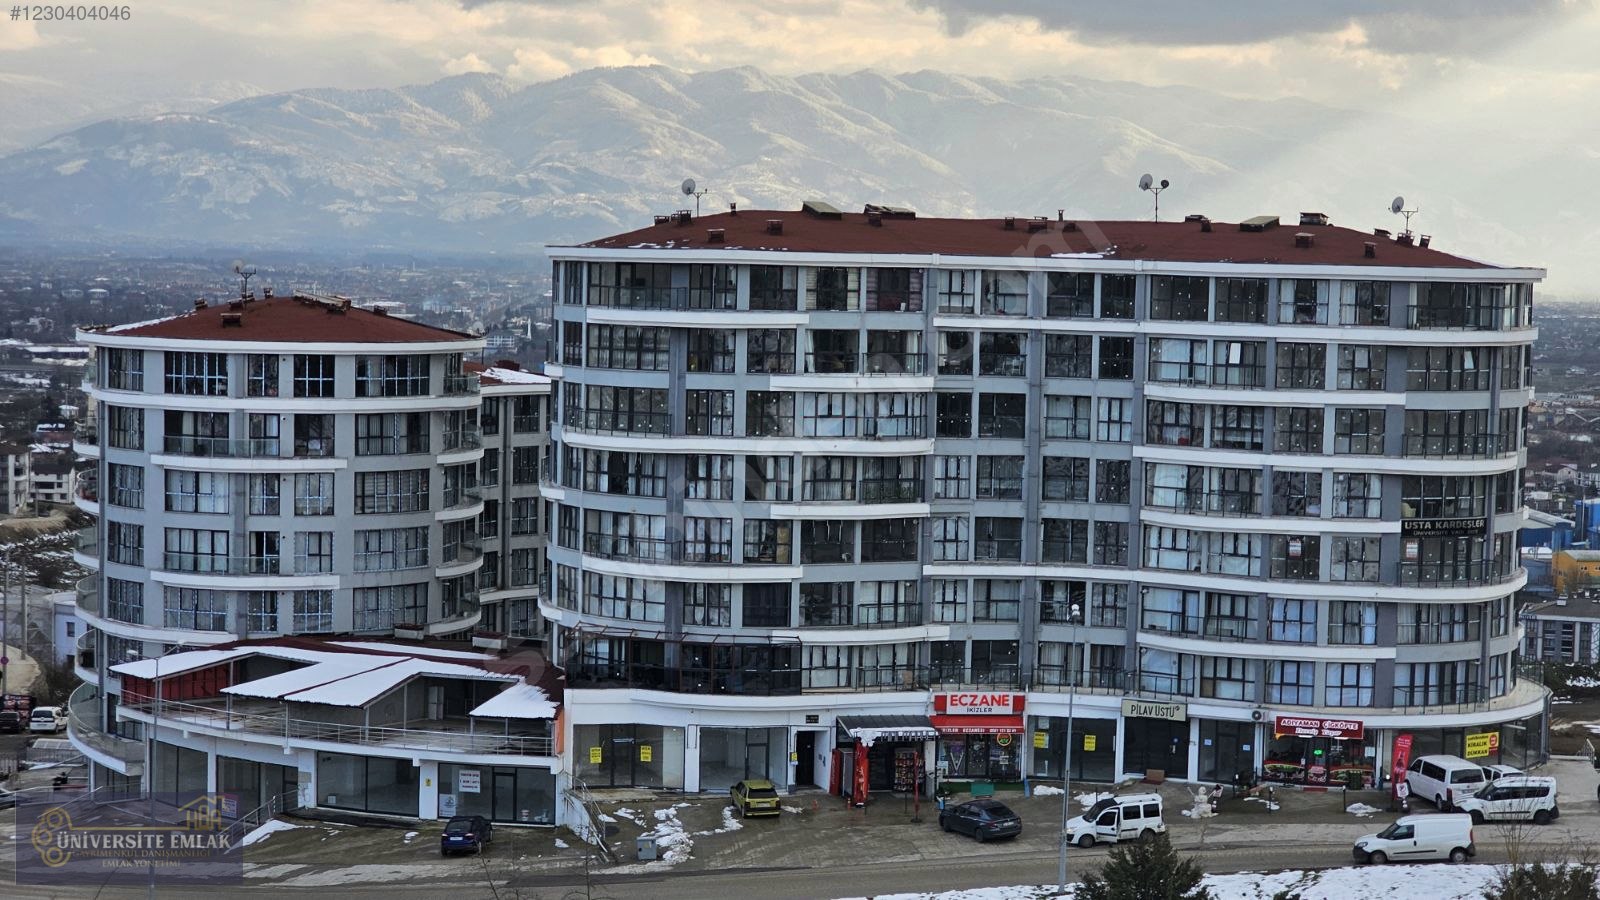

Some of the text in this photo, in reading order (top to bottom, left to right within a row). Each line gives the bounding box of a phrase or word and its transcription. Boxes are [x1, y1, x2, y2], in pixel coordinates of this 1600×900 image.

[1405, 521, 1431, 529] USTA
[950, 694, 1010, 707] ECZANE
[1281, 718, 1320, 728] ADIYAMAN
